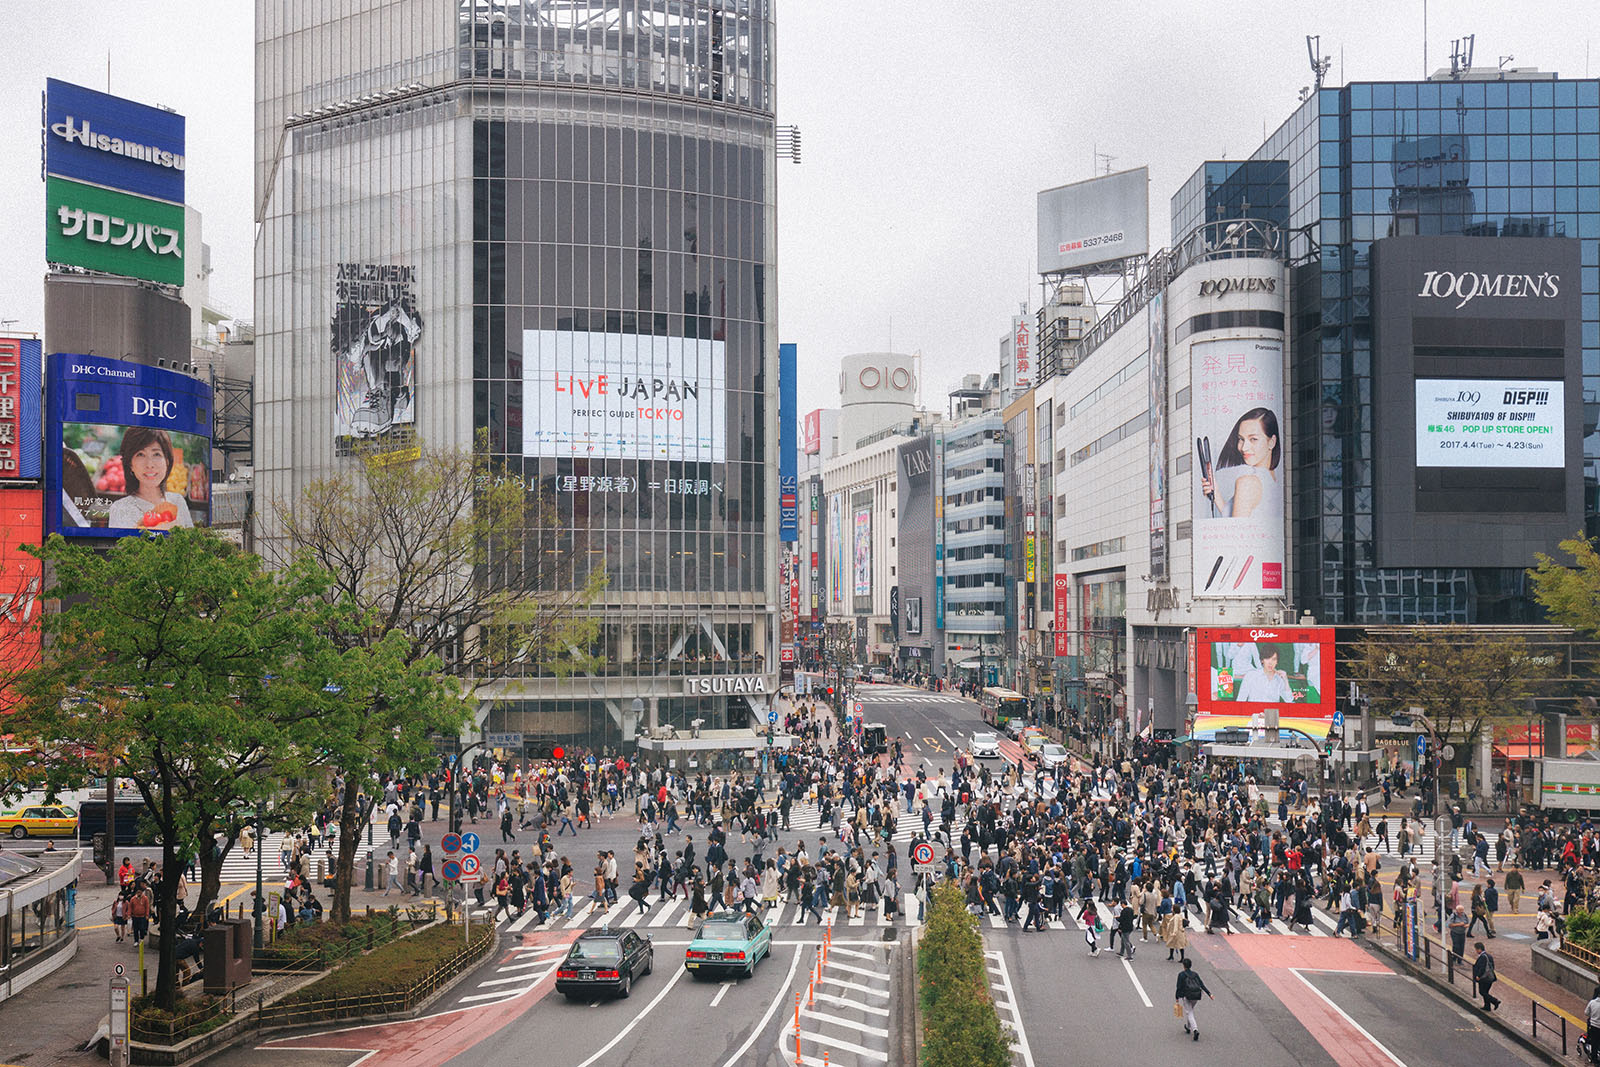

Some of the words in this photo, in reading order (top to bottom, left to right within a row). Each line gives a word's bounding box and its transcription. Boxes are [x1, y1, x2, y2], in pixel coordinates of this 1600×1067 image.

[51, 115, 185, 171] Hisamitsu
[57, 204, 182, 259] サロンパス
[1083, 232, 1123, 248] 5337-2468
[1418, 271, 1560, 310] 109MEN'S
[1016, 320, 1030, 373] 大和証券
[1255, 344, 1281, 352] Panasonic
[72, 364, 96, 376] DHC
[97, 366, 136, 379] Channel
[1201, 354, 1257, 376] 発見。
[554, 372, 608, 399] LIVE
[617, 377, 698, 402] JAPAN
[1457, 390, 1481, 406] 109
[1503, 391, 1549, 405] DISP!!!
[132, 396, 177, 420] DHC
[572, 409, 606, 417] PERFECT
[609, 410, 635, 418] GUIDE
[637, 407, 683, 421] TOKYO
[1447, 411, 1495, 421] SHIBUYA109
[1497, 412, 1507, 421] 8F
[1509, 412, 1536, 422] DISP!!!
[1462, 425, 1480, 433] POP
[1496, 426, 1524, 434] STORE
[1526, 426, 1553, 434] OPEN!
[1440, 440, 1495, 450] 2017.4.4(Tue)
[1506, 441, 1544, 450] 4.23(Sun)
[782, 475, 796, 529] SEIBU
[688, 678, 765, 694] TSUTAYA
